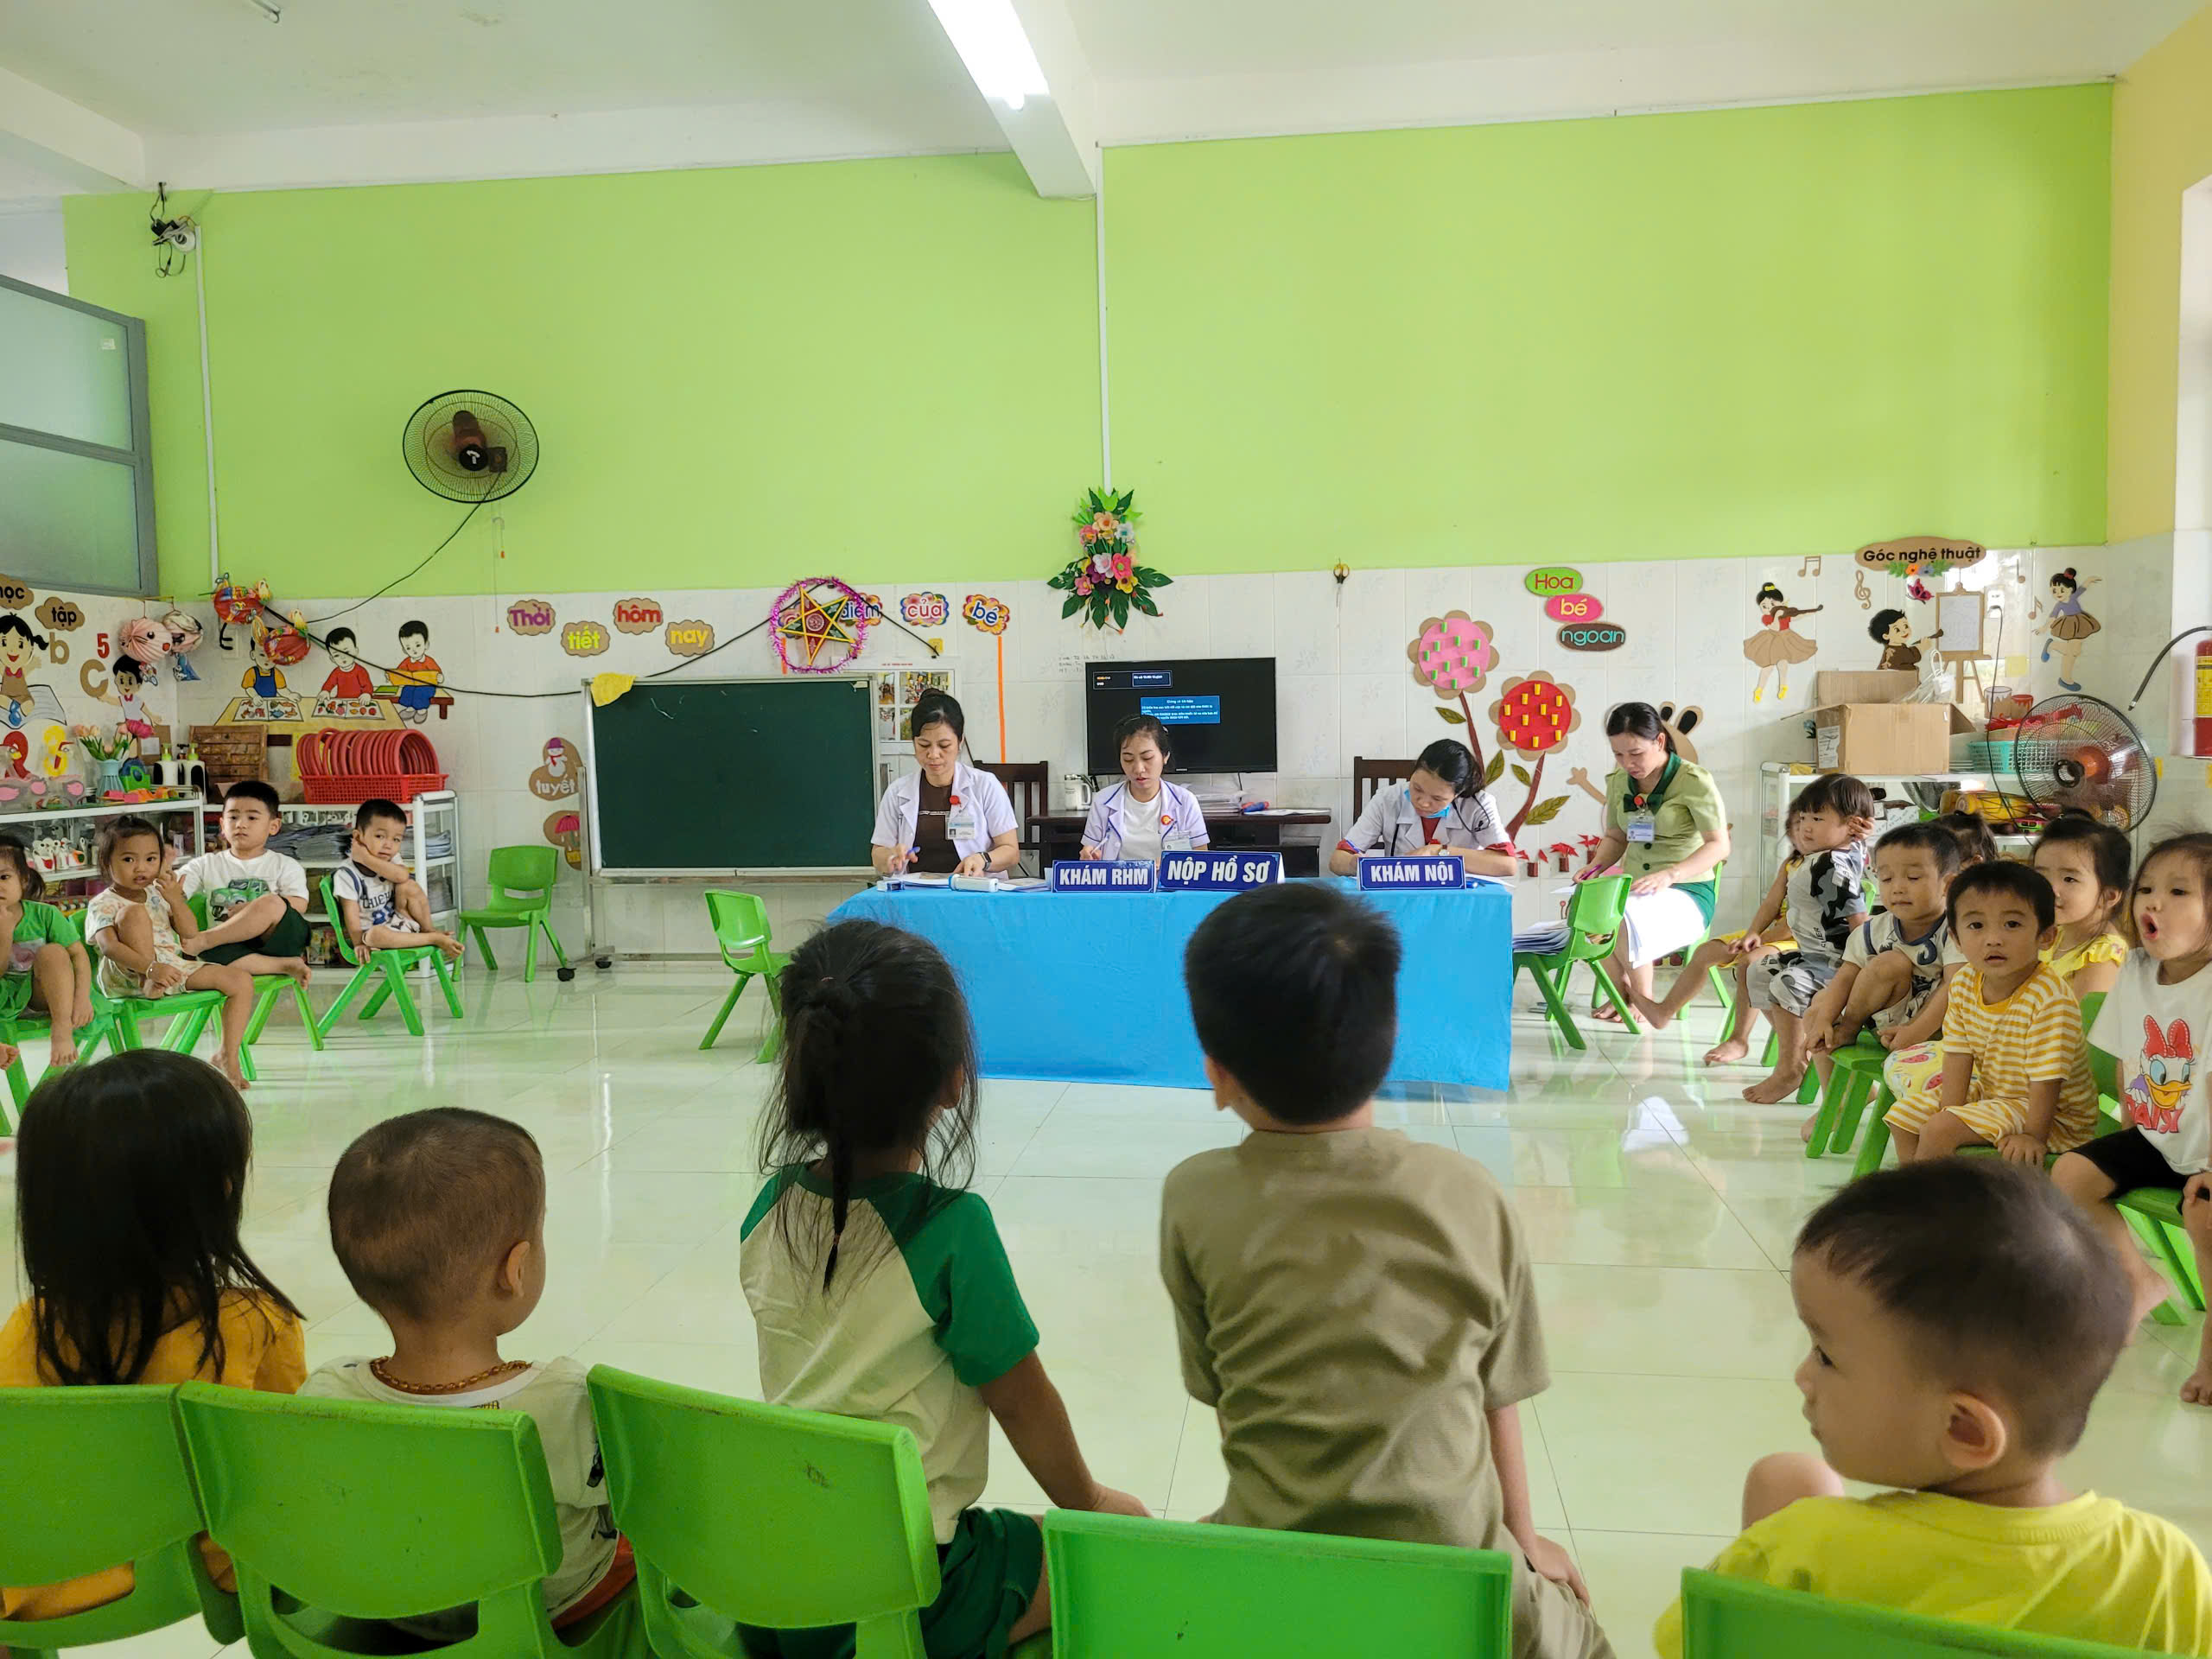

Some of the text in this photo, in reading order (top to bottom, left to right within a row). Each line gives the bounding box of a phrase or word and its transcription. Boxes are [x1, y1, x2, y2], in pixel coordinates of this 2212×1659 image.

[1863, 546, 1980, 563] Góc nghệ thuật
[1535, 574, 1573, 589] Hoa
[51, 607, 77, 626] tập
[907, 598, 942, 617] của
[972, 601, 998, 624] bé
[1560, 598, 1587, 616] bé
[510, 603, 709, 650] Thời tiết hôm nay
[97, 632, 110, 658] 5
[1561, 630, 1624, 646] ngoan
[536, 774, 575, 797] tuyết
[1059, 865, 1148, 886] KHÁM RHM
[1167, 855, 1270, 885] NỘP HỒ SƠ
[1370, 861, 1454, 885] KHÁM NỘI
